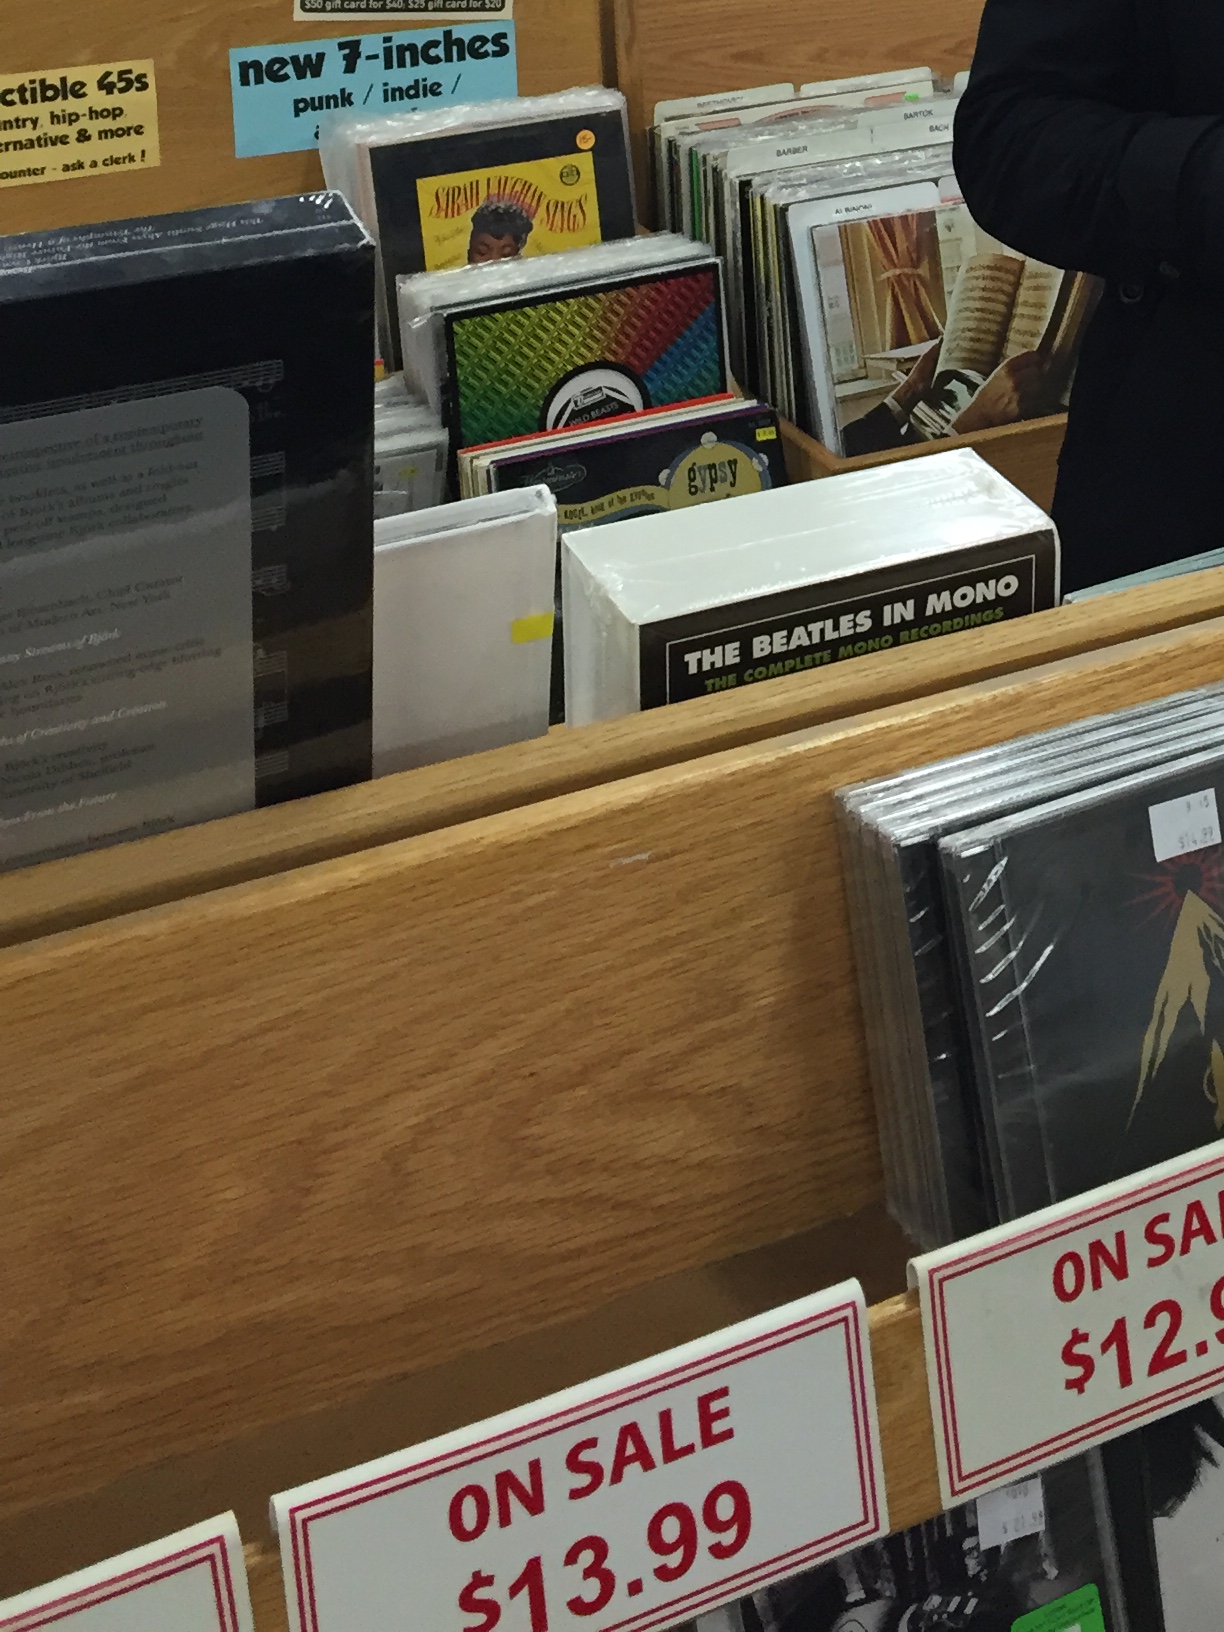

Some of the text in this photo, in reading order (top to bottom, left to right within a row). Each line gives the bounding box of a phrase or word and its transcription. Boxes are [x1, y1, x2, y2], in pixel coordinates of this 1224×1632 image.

[304, 0, 323, 9] $50
[344, 0, 367, 9] card
[369, 0, 384, 9] for
[445, 0, 467, 9] card
[469, 0, 484, 9] for
[238, 30, 511, 88] new 7-inches
[97, 69, 150, 96] 45s
[293, 78, 443, 118] punk indie
[75, 124, 145, 144] & more
[902, 108, 934, 121] BARTOK
[928, 123, 950, 133] BACH
[62, 152, 136, 173] ask a clerk
[775, 144, 809, 158] BARBER
[428, 179, 481, 219] SARAH
[541, 192, 588, 234] SINGS
[590, 401, 620, 418] BEASTS
[687, 457, 739, 497] gypsy
[684, 573, 1020, 676] THE BEATLES IN MONO
[704, 605, 1006, 693] THE COMPLETE MONO RECORDINGS
[1051, 1229, 1129, 1304] ON
[447, 1386, 736, 1544] ON SALE
[455, 1478, 754, 1632] $13.99
